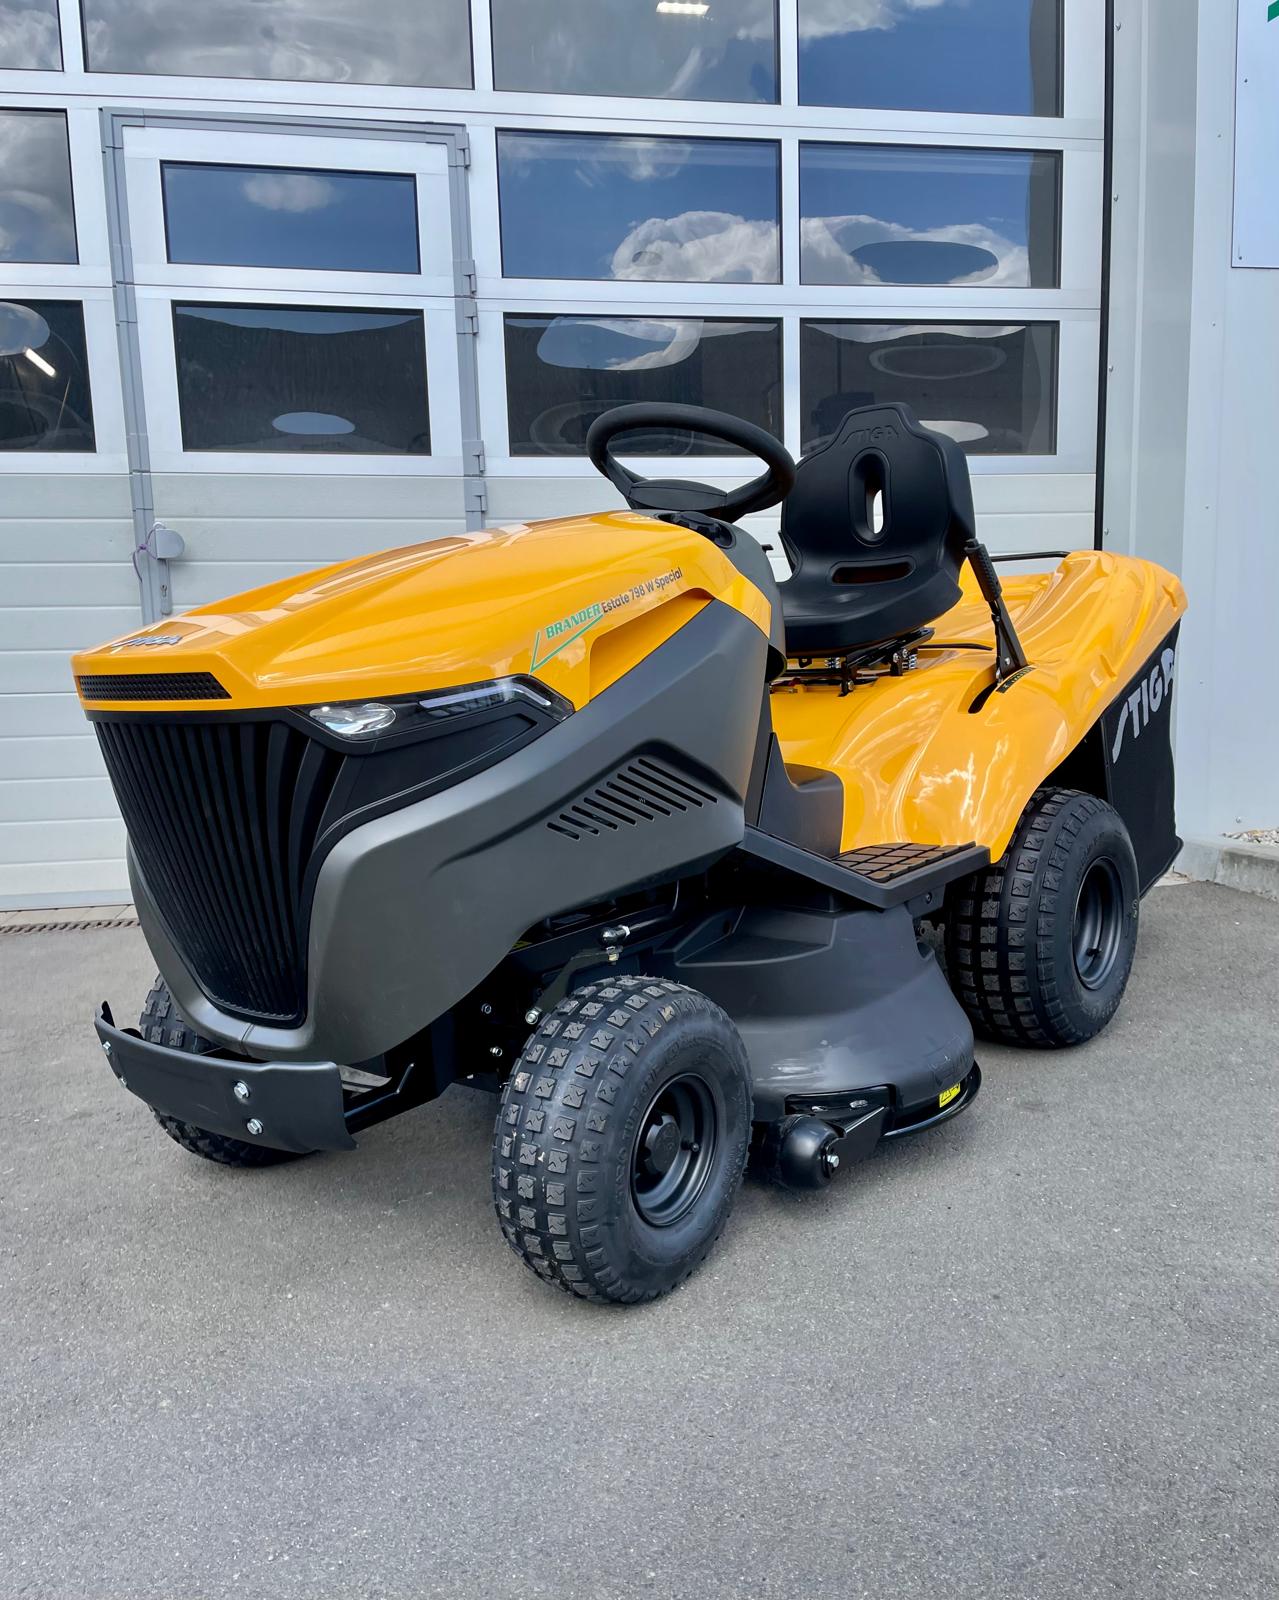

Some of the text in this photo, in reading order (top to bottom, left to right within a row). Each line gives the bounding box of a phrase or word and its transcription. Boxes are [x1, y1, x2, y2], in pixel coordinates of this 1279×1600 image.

[842, 424, 899, 446] STIGA
[545, 567, 683, 639] BRANDER Estate 798 W Special
[1111, 647, 1174, 764] STIGA
